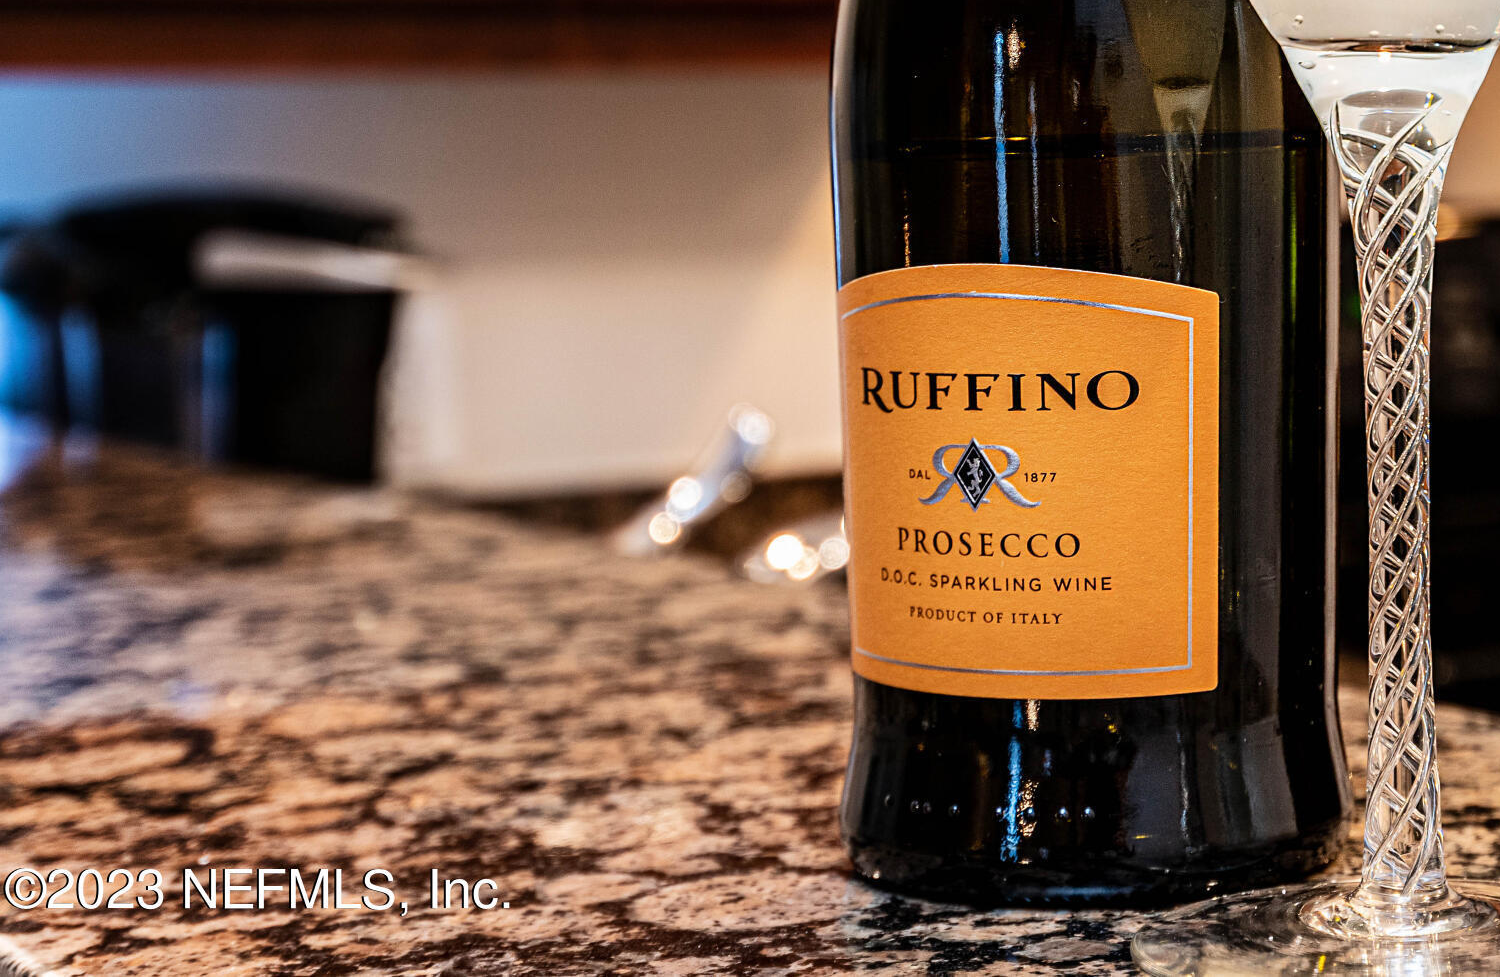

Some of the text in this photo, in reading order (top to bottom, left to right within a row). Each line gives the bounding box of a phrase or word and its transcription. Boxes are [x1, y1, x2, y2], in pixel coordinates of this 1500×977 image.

[861, 367, 1140, 413] RUFFINO
[908, 468, 931, 481] DAL
[1023, 472, 1057, 483] 1877
[897, 526, 1081, 558] PROSECCO
[880, 567, 1113, 593] D.O.C. SPARKLING WINE
[909, 606, 1064, 625] PRODUCT OF ITALY
